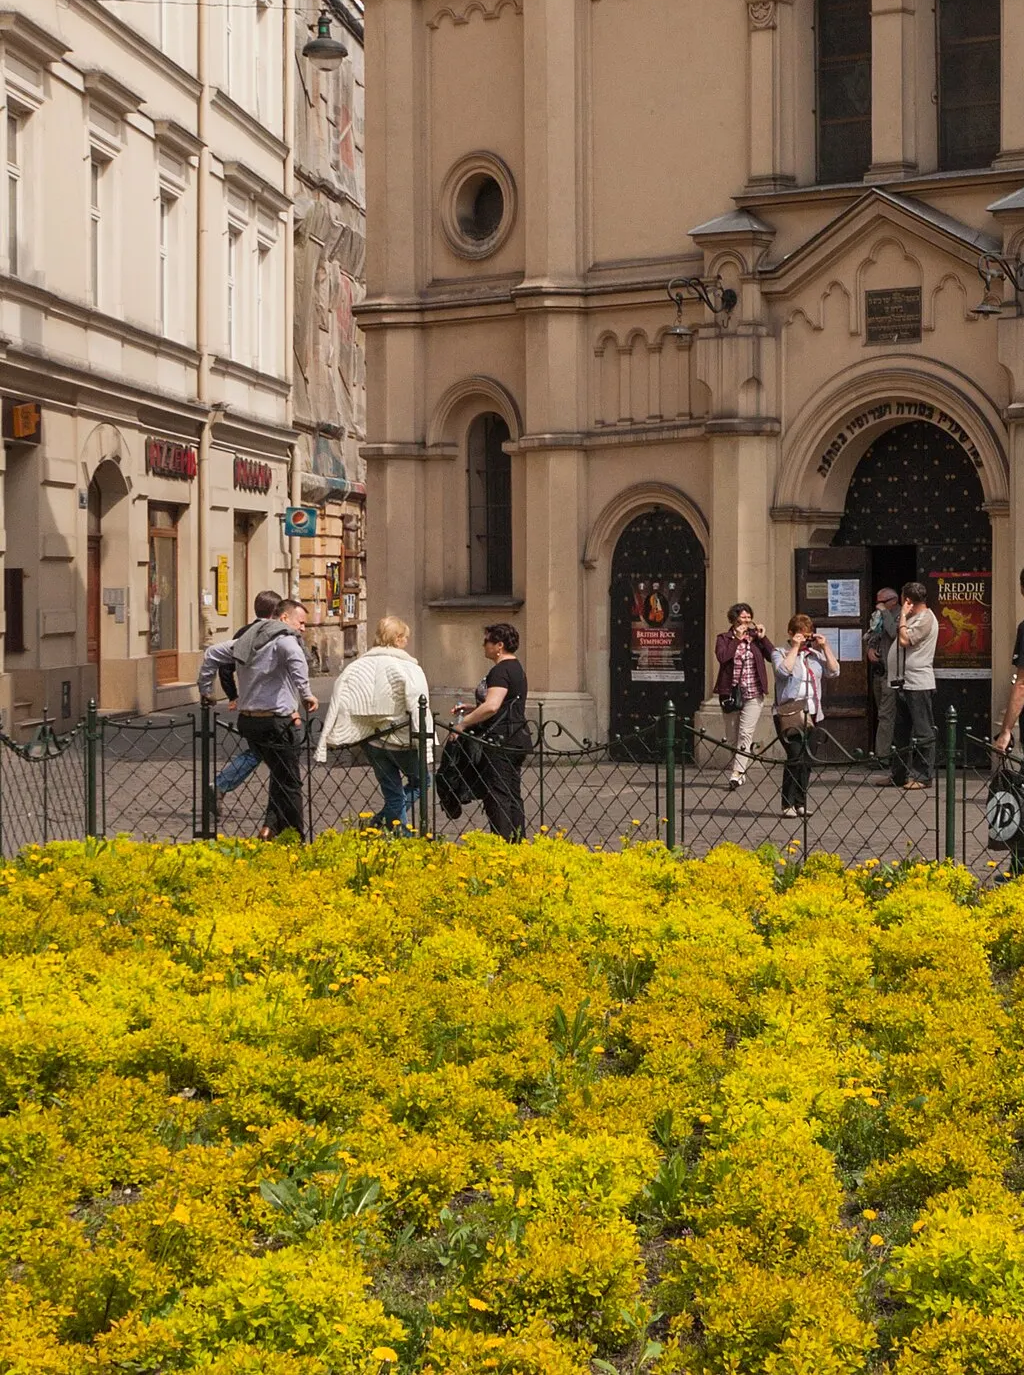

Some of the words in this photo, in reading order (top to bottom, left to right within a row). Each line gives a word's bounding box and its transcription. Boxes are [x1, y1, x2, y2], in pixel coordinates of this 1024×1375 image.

[939, 582, 985, 593] FREDDIE
[938, 592, 986, 603] MERCURY
[659, 630, 676, 638] ROCK
